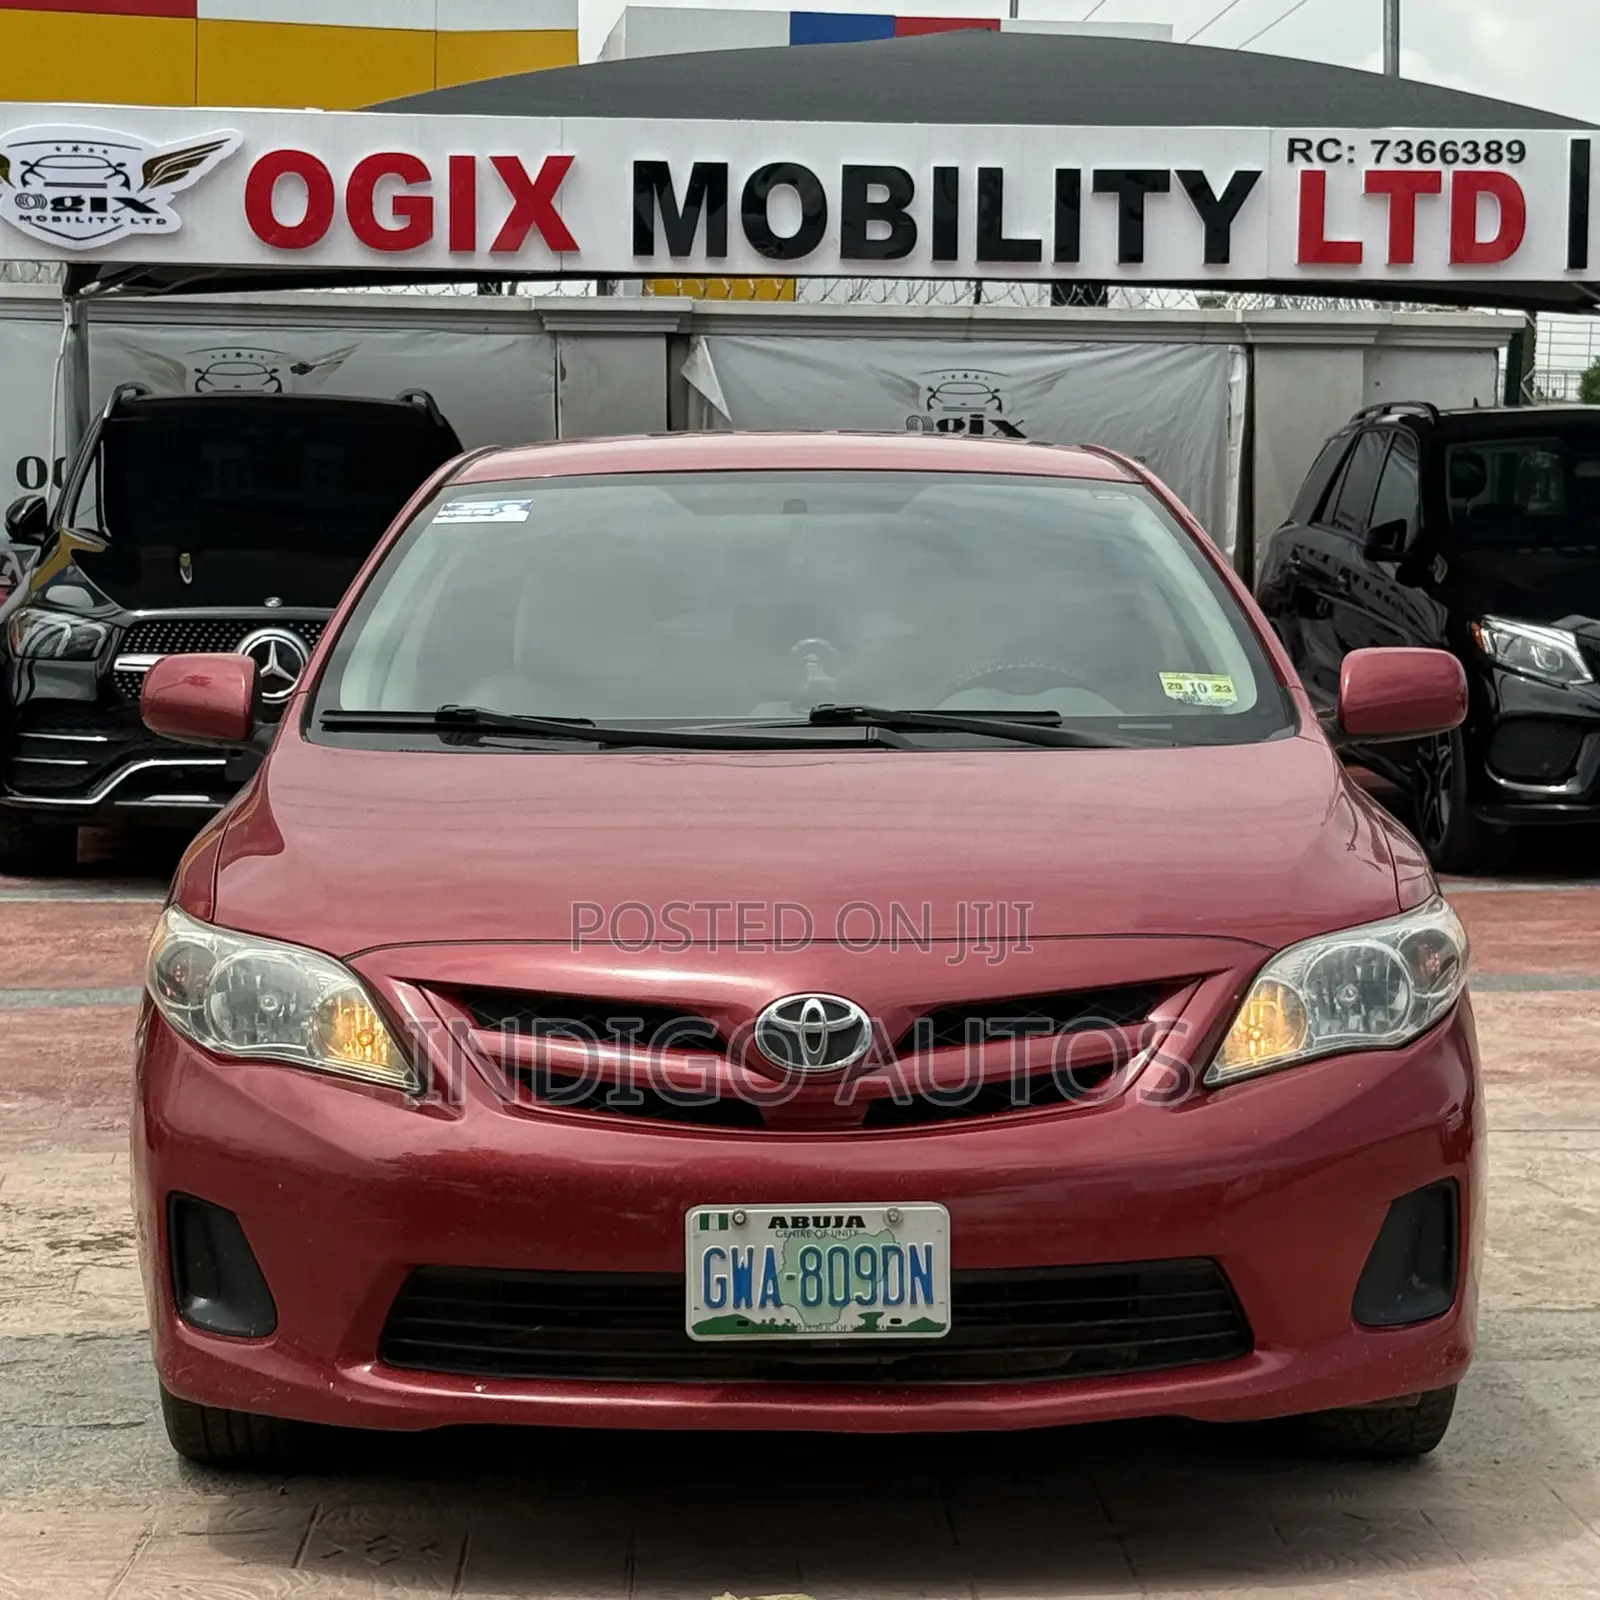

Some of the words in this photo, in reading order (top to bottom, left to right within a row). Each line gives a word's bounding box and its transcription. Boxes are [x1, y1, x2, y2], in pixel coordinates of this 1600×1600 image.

[1287, 138, 1355, 164] RC:
[1370, 140, 1526, 165] 7366389
[244, 149, 580, 253] OGIX
[632, 160, 1263, 266] MOBILITY
[1297, 170, 1527, 265] LTD
[18, 214, 122, 224] MOBILITY
[130, 217, 167, 226] LTD
[768, 1215, 866, 1229] ABUJA
[775, 1229, 813, 1238] CENTRE
[831, 1229, 859, 1238] UNITY
[702, 1243, 934, 1310] GWA-809DN
